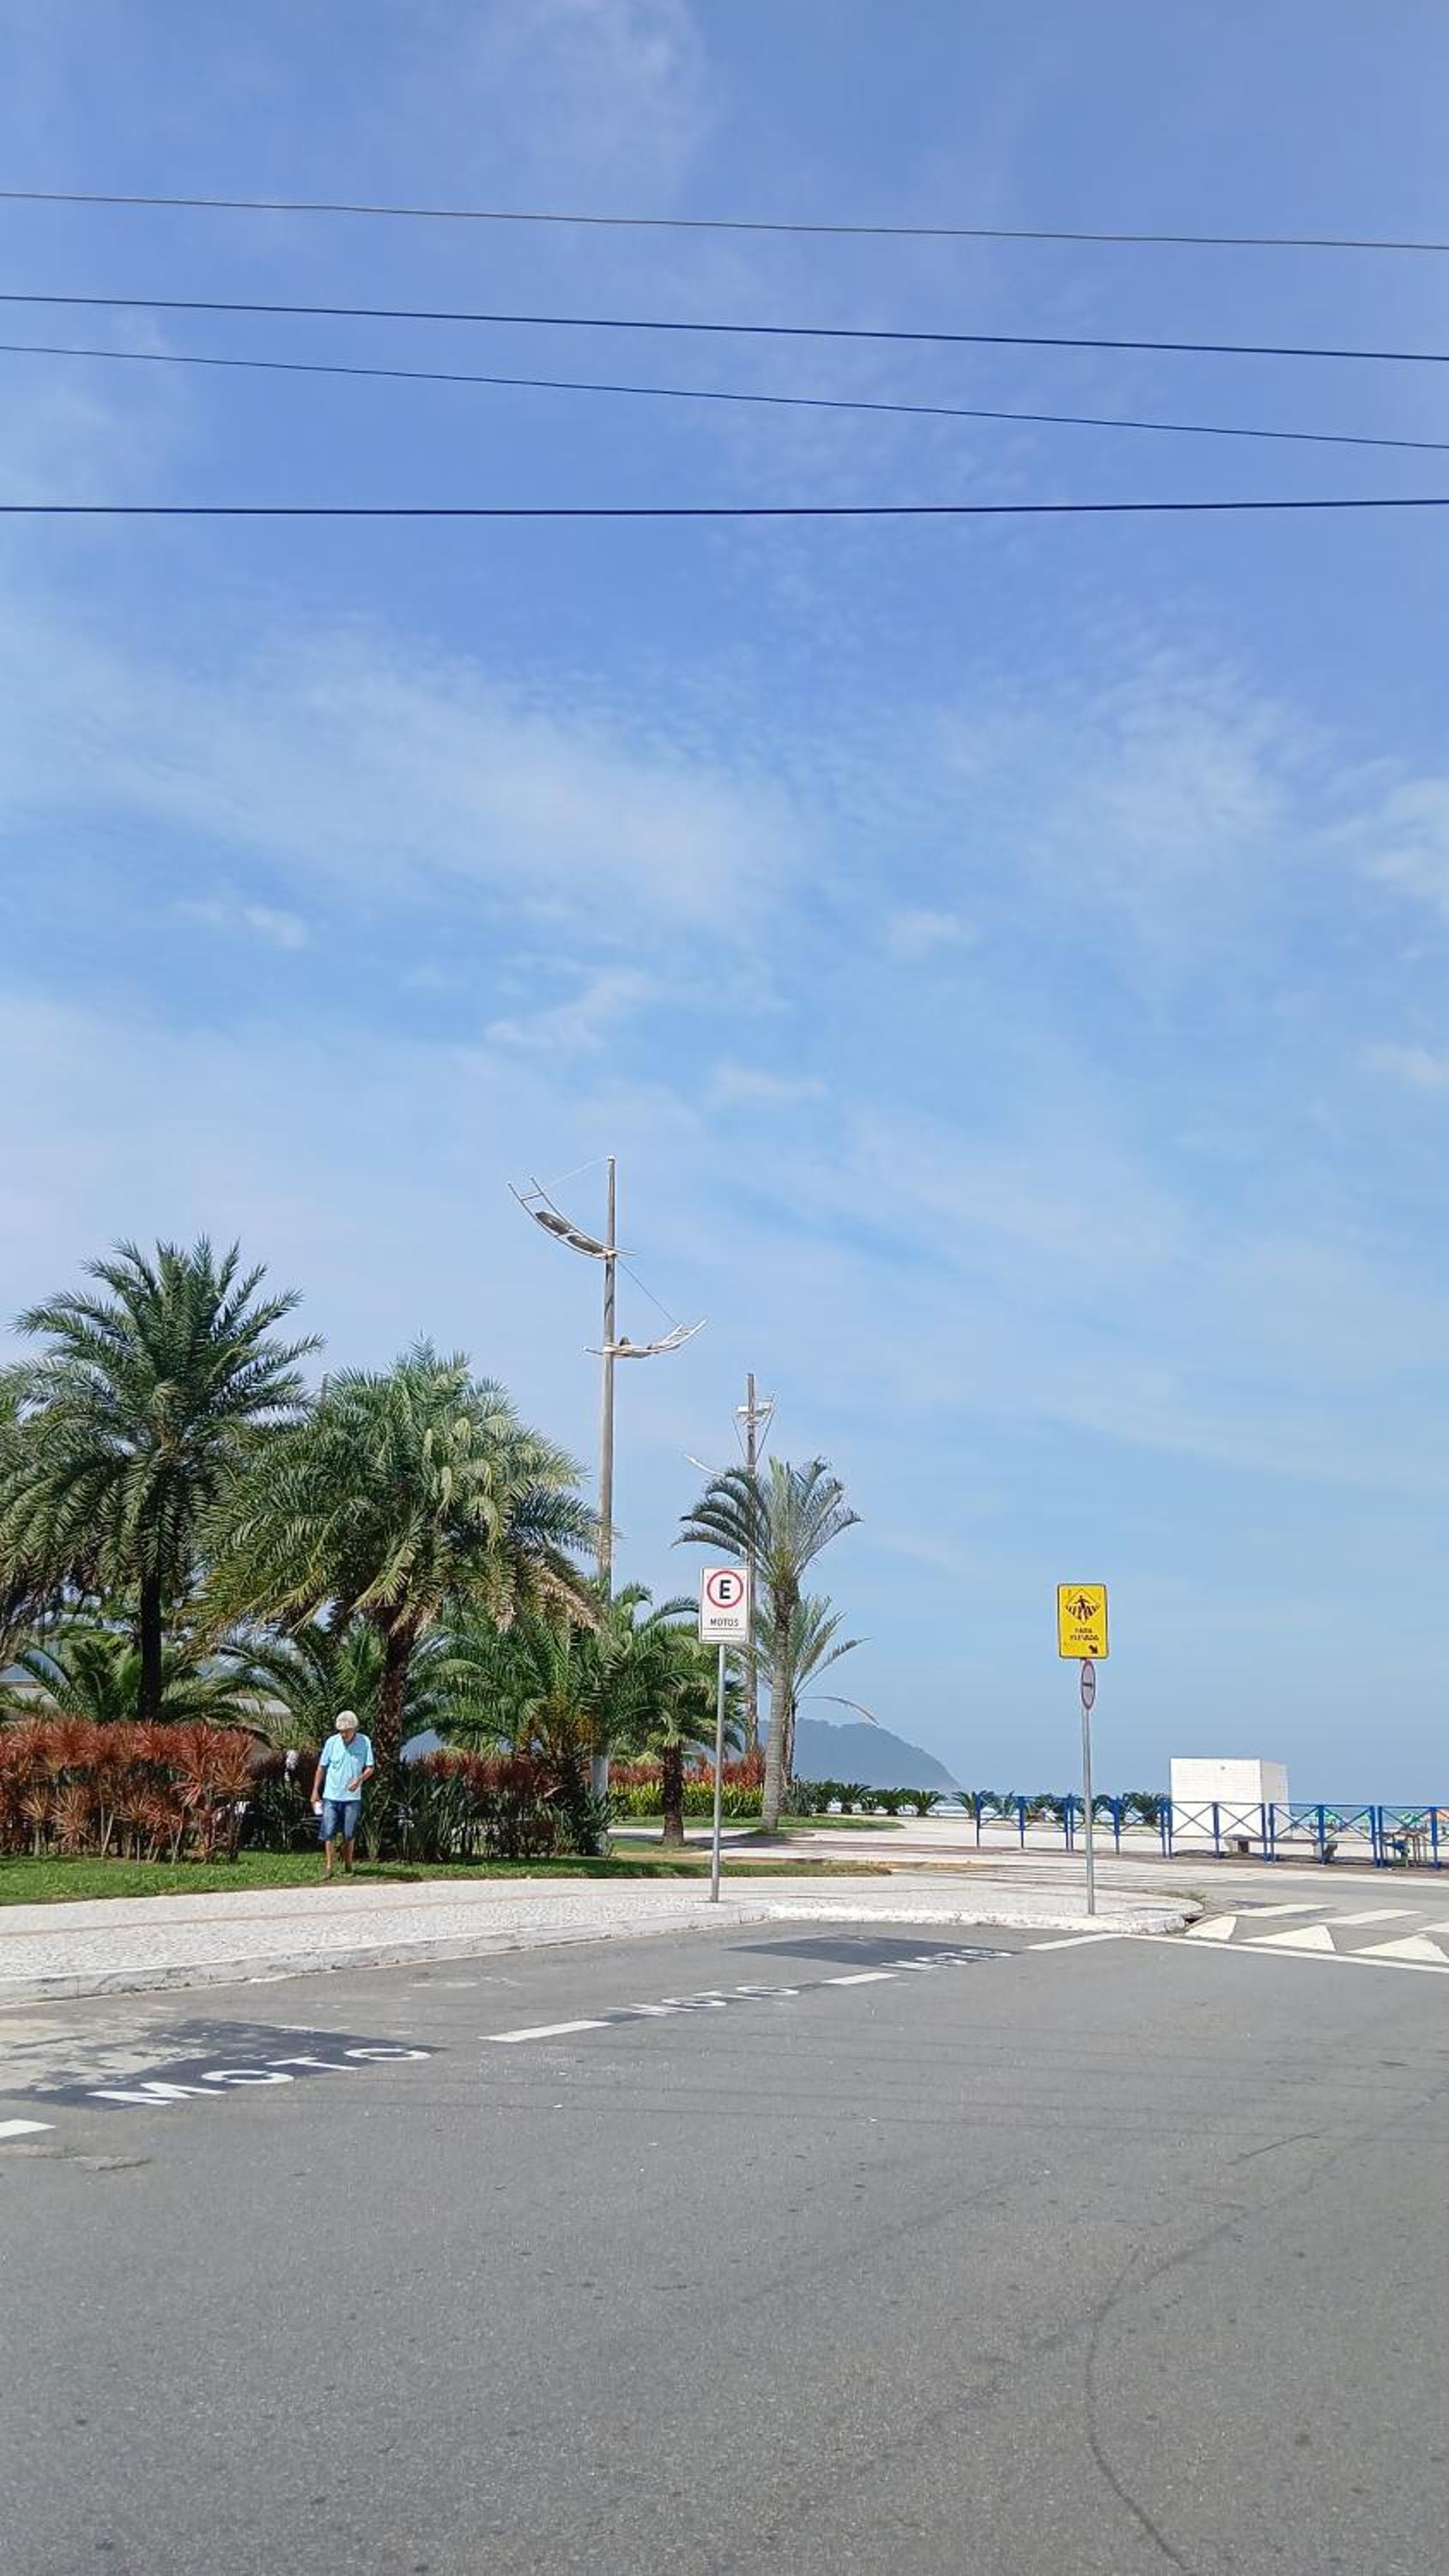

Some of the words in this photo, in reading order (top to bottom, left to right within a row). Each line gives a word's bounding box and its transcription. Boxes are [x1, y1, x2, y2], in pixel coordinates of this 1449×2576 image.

[718, 1580, 732, 1600] E
[710, 1618, 739, 1627] MOTOS
[880, 1948, 1014, 1971] MOTO
[605, 1985, 800, 2016] MOTO
[87, 2048, 432, 2105] MOTO
